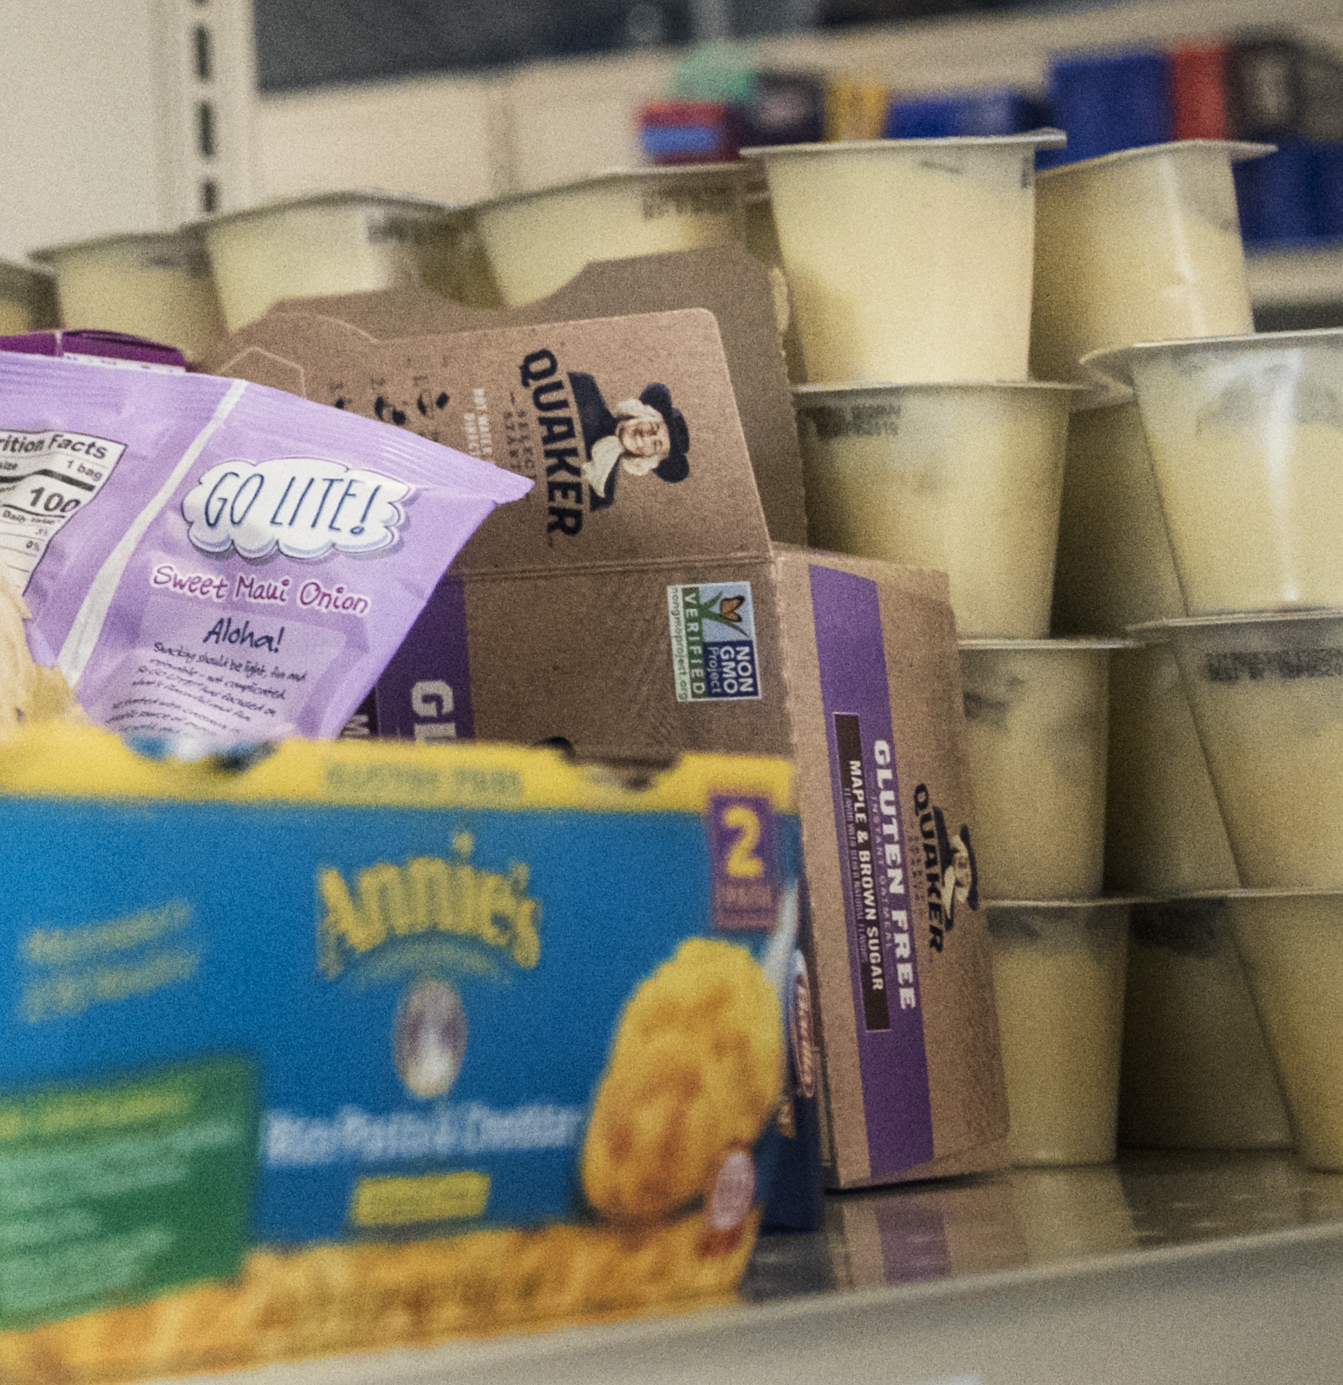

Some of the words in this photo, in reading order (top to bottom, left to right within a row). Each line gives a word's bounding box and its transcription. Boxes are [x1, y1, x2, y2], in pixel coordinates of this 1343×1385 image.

[47, 434, 108, 460] Facts
[464, 413, 482, 457] DIRECT
[504, 411, 521, 472] START
[520, 348, 584, 536] QUAKER
[29, 486, 82, 514] 100
[77, 461, 103, 482] bag
[204, 471, 264, 528] GO
[270, 476, 382, 535] LITE!
[153, 565, 228, 599] Sweet
[234, 575, 290, 603] Maui
[299, 581, 369, 614] Onion
[202, 617, 285, 653] Aloha!
[684, 593, 706, 694] VERIFIED
[708, 646, 722, 693] Project
[720, 645, 738, 694] GMO
[736, 646, 754, 692] NON
[849, 760, 867, 824] MAPLE
[723, 805, 764, 878] 2
[856, 829, 869, 843] &
[858, 849, 878, 921] BROWN
[874, 739, 905, 894] GLUTEN
[891, 909, 916, 1010] FREE
[913, 783, 943, 952] QUAKER
[878, 874, 892, 949] OATMEAL
[866, 926, 884, 990] SUGAR
